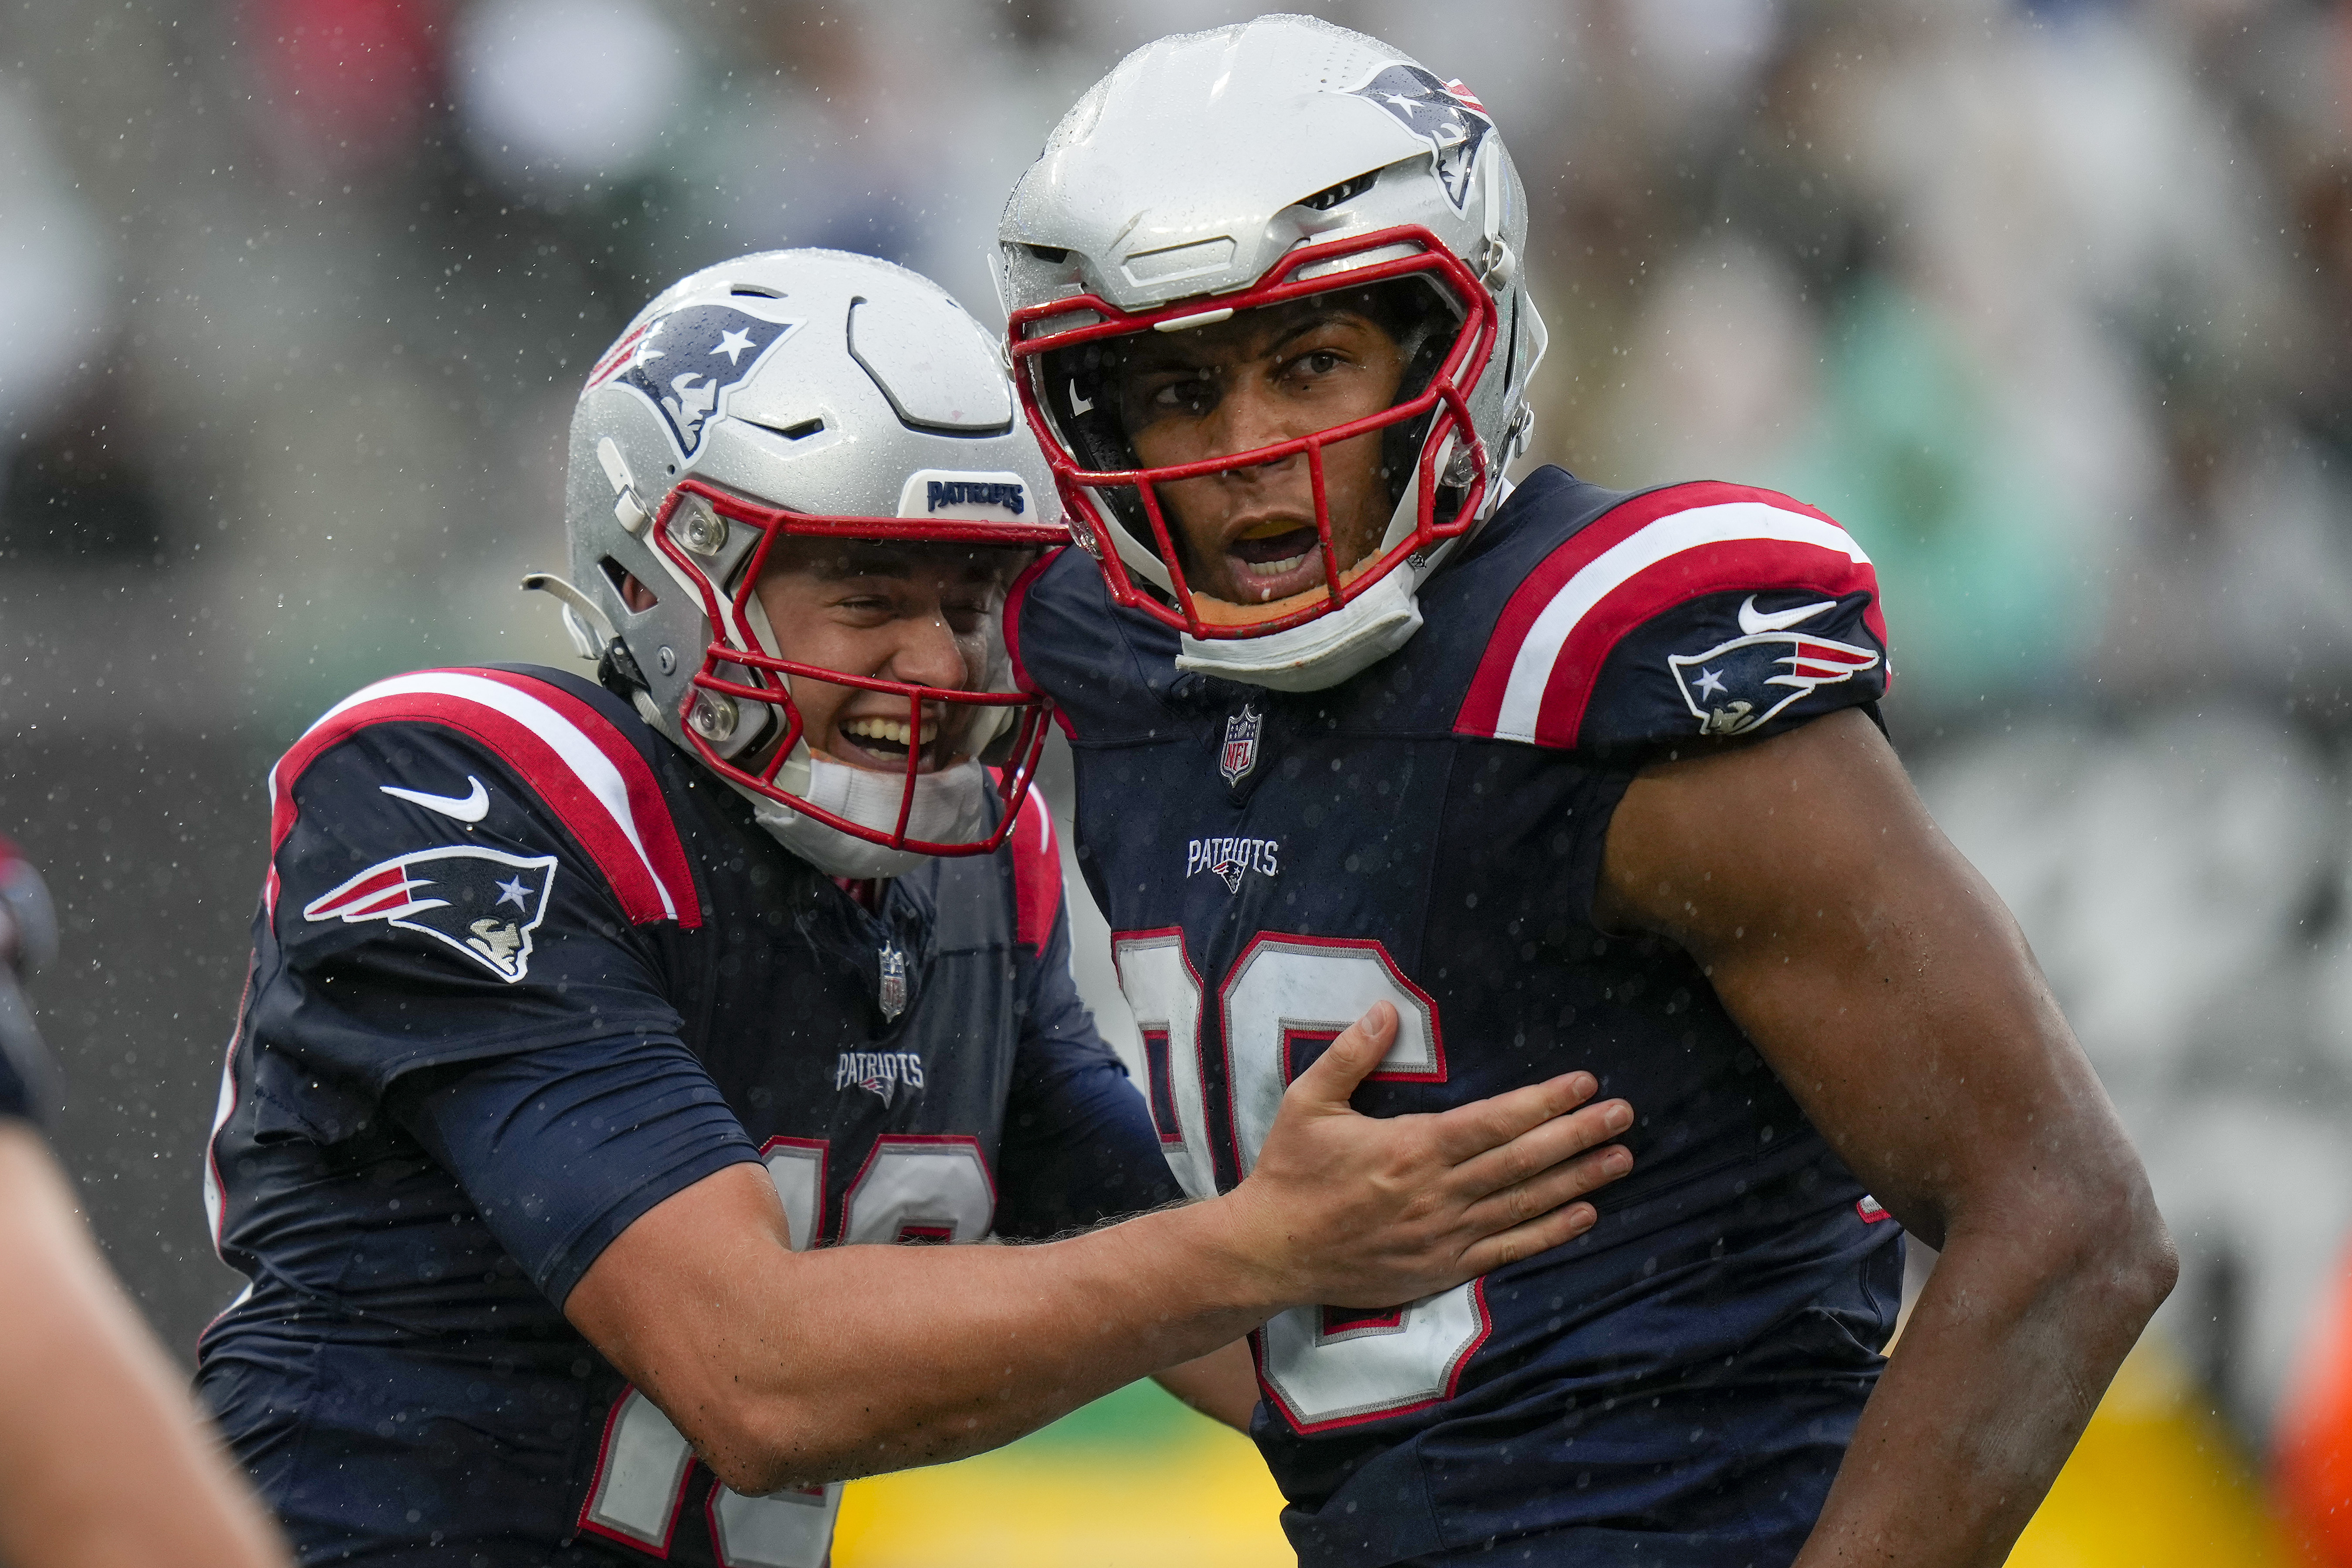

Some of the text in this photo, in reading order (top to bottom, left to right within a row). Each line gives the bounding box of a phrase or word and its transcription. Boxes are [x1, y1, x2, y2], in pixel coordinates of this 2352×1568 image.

[927, 481, 1024, 515] PATRIOTS
[1224, 742, 1250, 771] NFL
[1186, 837, 1279, 879] PATRIOTS
[835, 1052, 924, 1092] PATRIOTS
